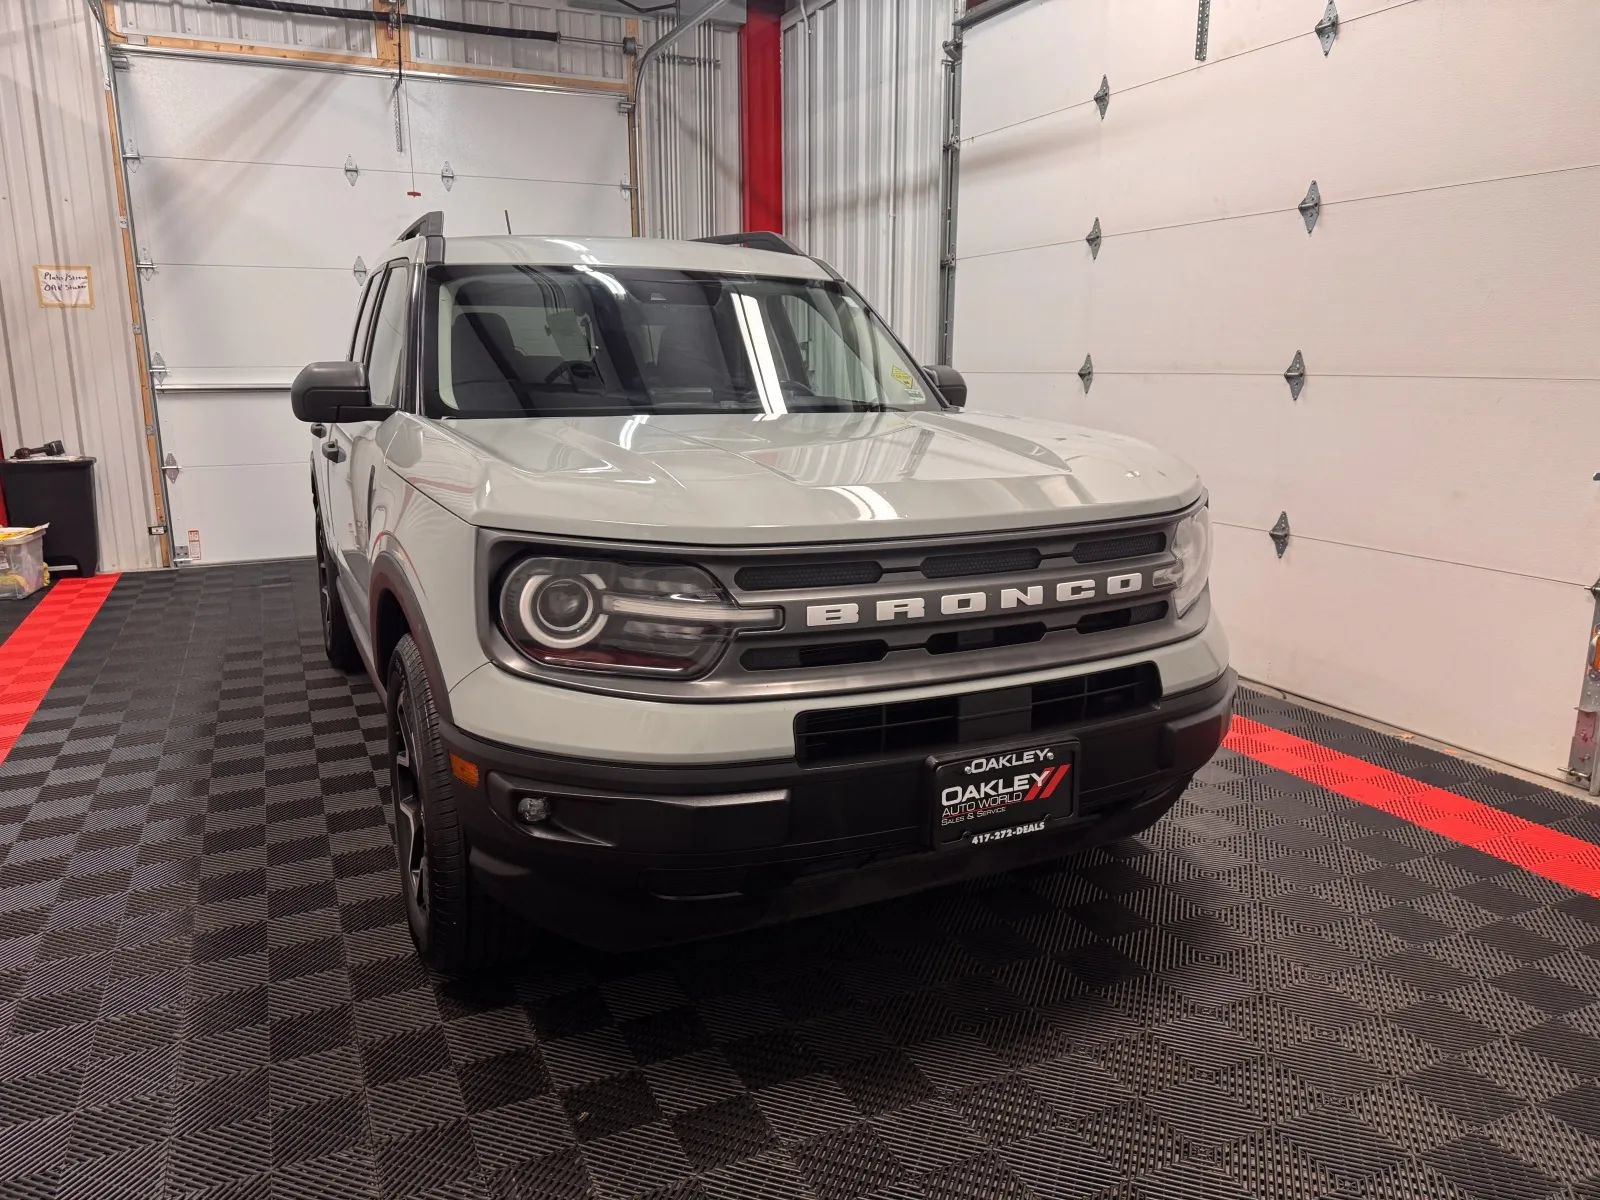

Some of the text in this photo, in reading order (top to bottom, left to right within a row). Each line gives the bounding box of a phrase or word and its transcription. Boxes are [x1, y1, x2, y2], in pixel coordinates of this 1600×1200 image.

[806, 572, 1142, 627] BRONCO
[971, 748, 1050, 774] OAKLEY
[941, 770, 1051, 806] OAKLEY
[941, 806, 1007, 826] SALES & SERVICE
[942, 792, 1023, 817] AUTO WORLD
[971, 822, 1045, 845] 417-272-DEALS
